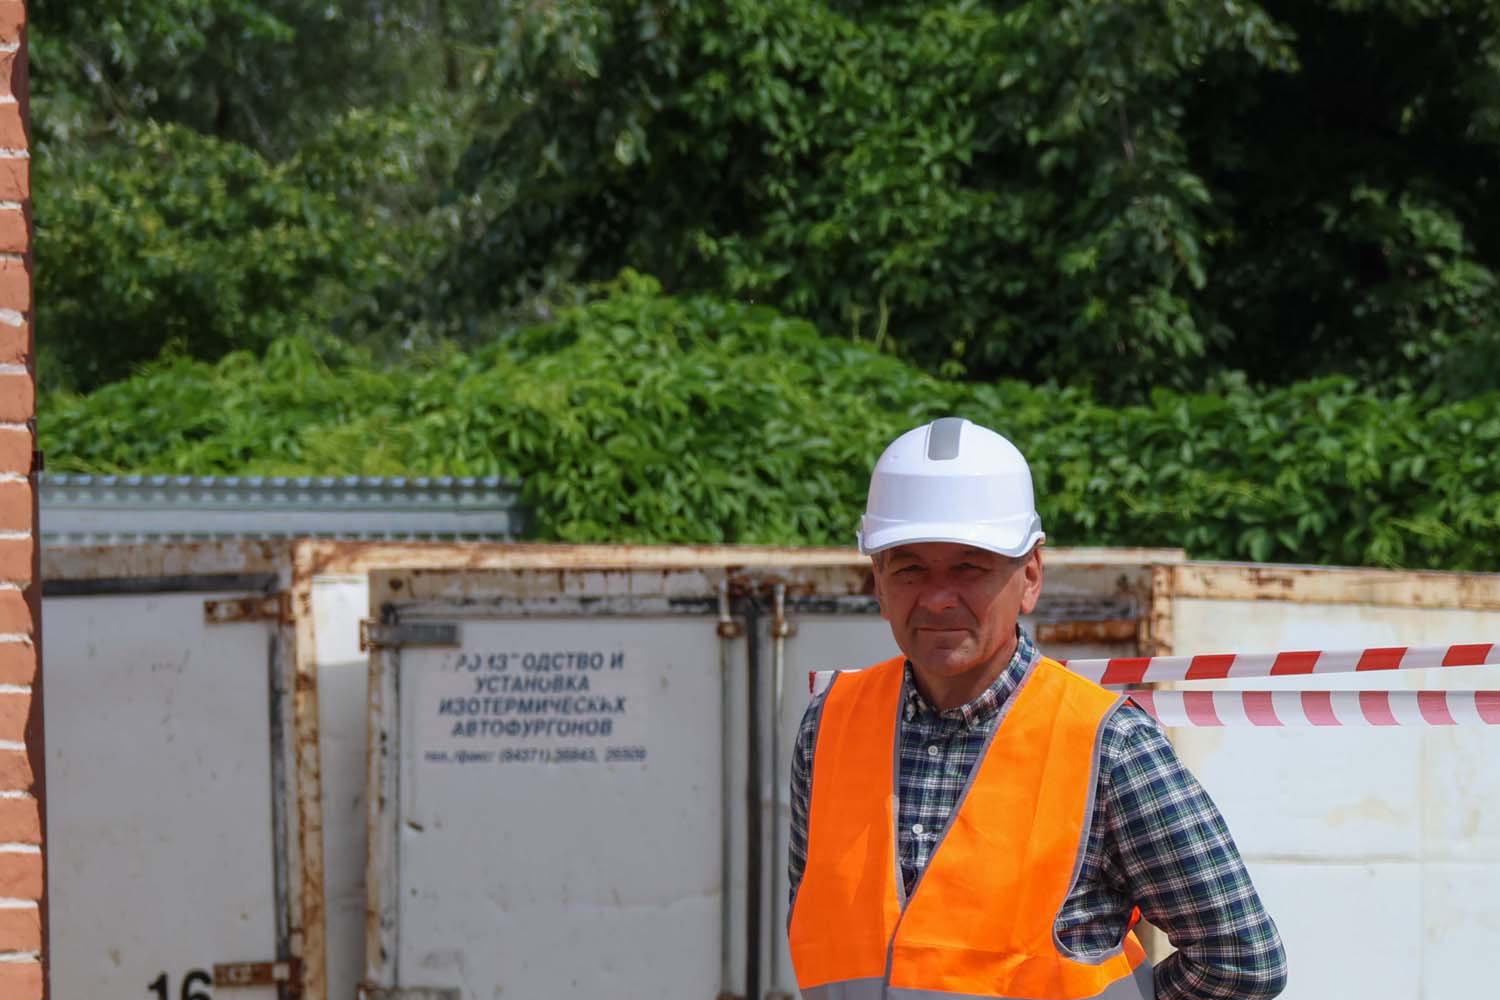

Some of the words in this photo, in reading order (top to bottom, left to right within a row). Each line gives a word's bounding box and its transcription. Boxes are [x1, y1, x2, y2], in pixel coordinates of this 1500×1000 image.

[609, 651, 625, 671] И
[474, 674, 590, 695] УСТАНОВКА
[451, 717, 613, 739] АВТОФУРГОНОВ
